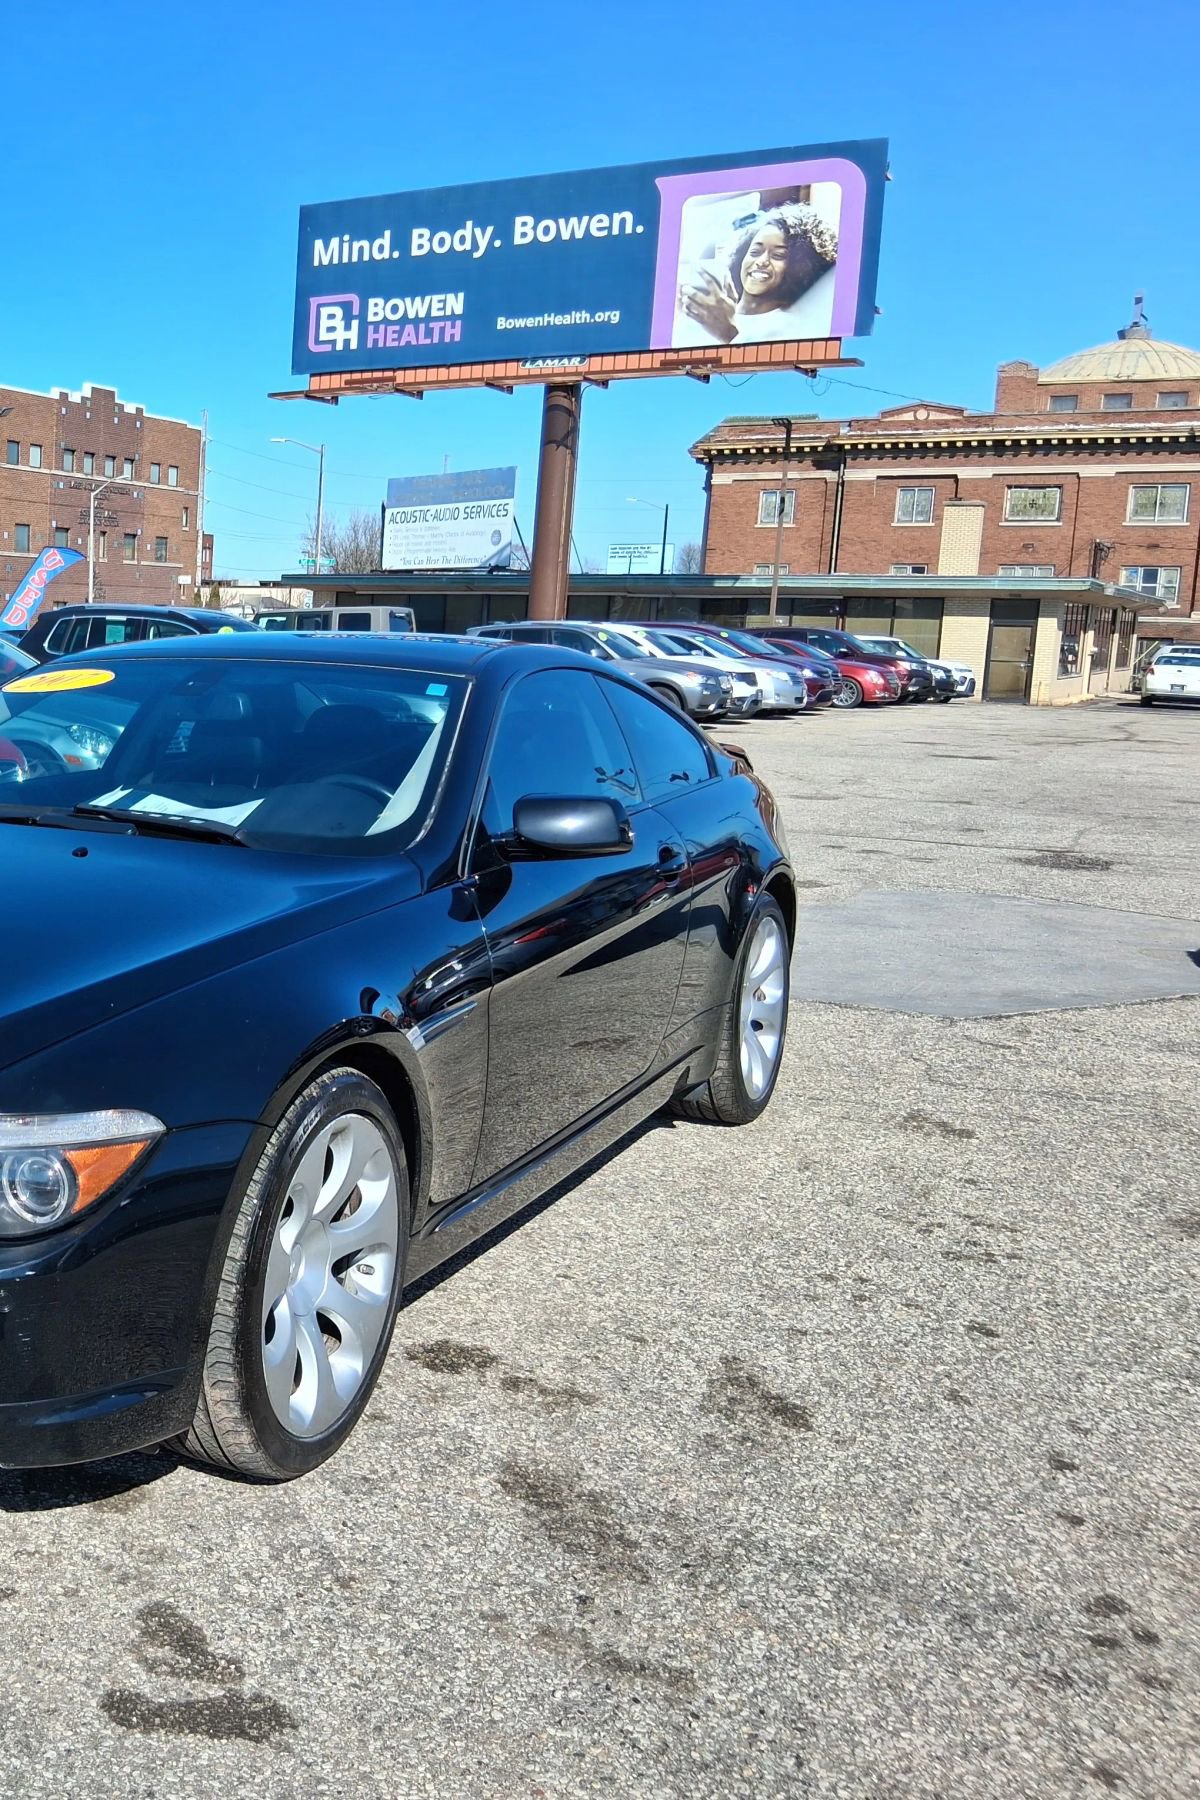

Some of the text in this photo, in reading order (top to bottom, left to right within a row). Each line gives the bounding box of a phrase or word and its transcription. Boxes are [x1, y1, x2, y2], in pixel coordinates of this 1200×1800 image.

[313, 210, 645, 267] Mind. Body. Bowen.
[367, 292, 465, 322] BOWEN
[496, 310, 620, 330] BowenHealth.org
[366, 320, 462, 348] HEALTH
[525, 356, 582, 368] LAMAR
[463, 503, 509, 520] SERVICES
[3, 549, 65, 626] USED
